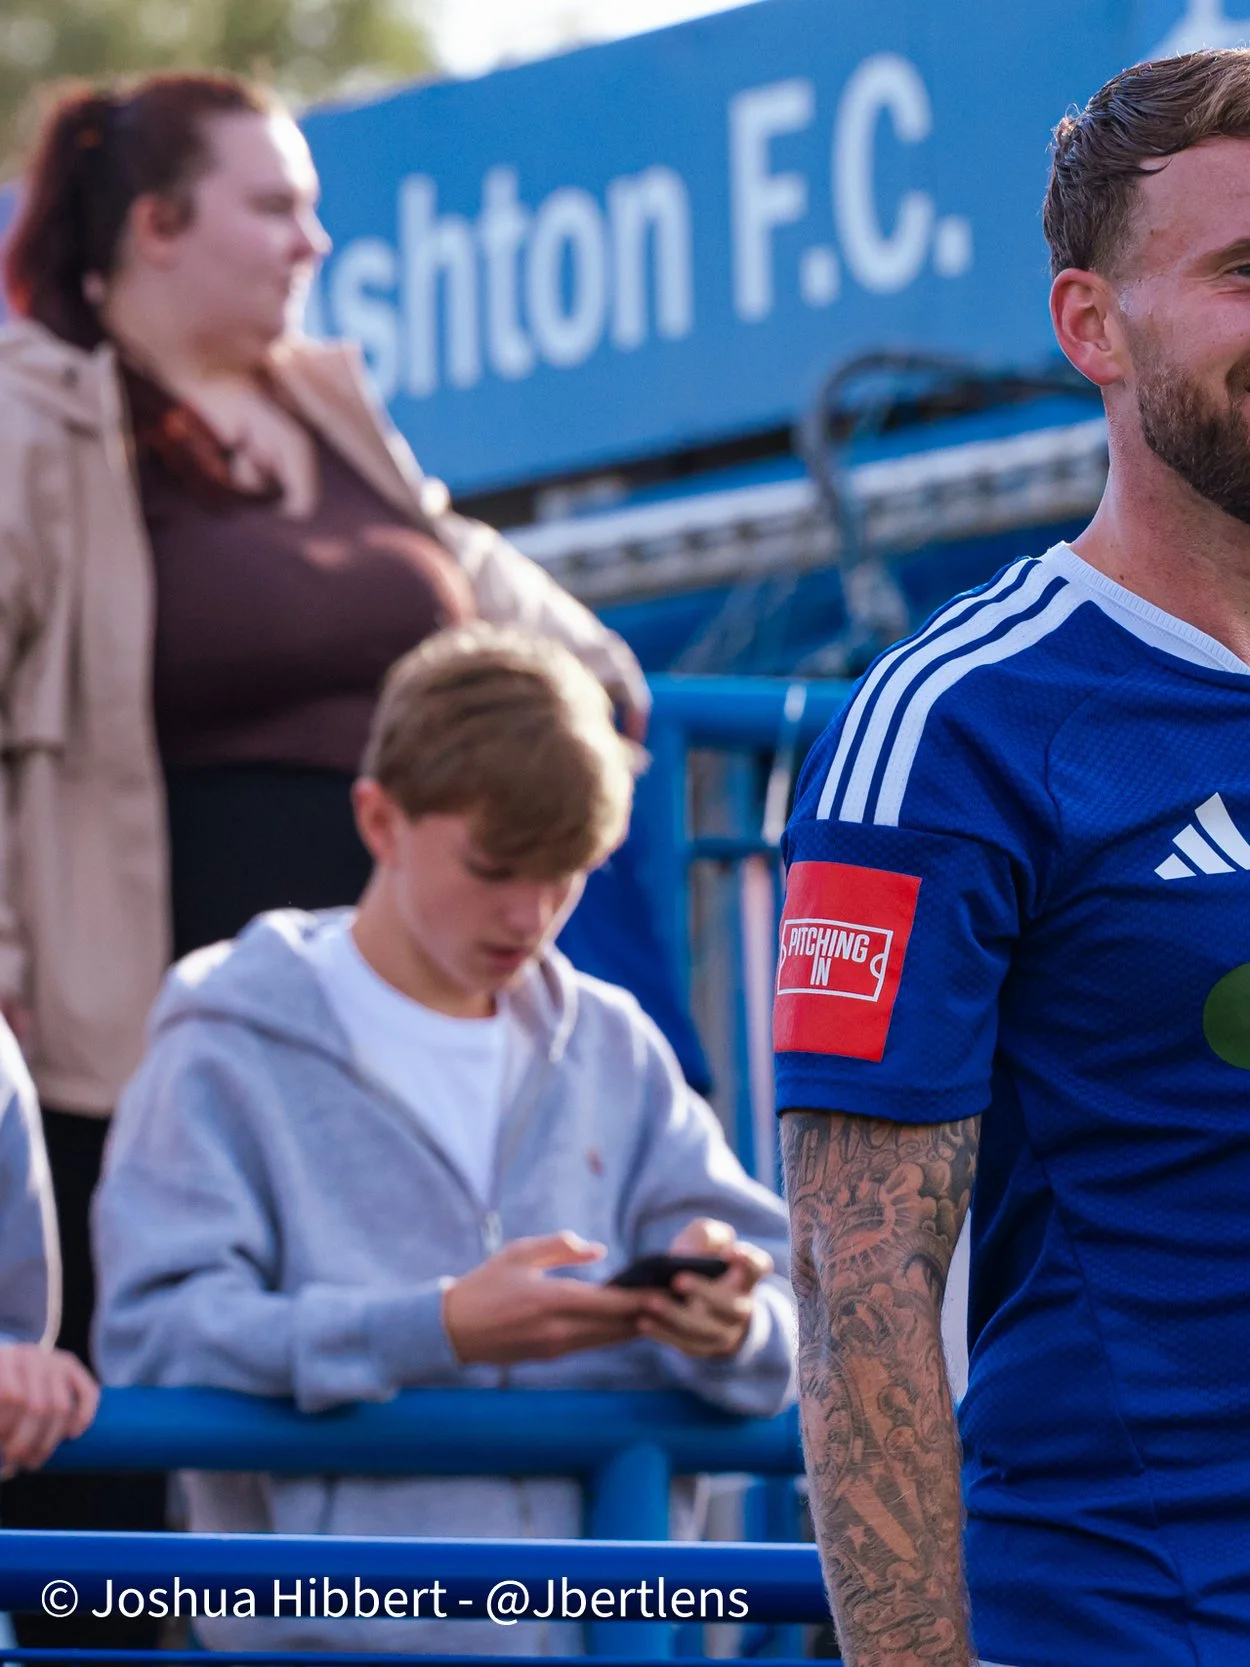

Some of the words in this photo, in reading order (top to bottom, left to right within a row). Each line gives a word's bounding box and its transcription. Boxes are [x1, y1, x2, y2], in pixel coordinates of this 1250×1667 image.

[305, 165, 692, 398] shton
[729, 53, 973, 322] F.C.
[788, 926, 870, 963] PITCHING
[810, 956, 831, 986] IN
